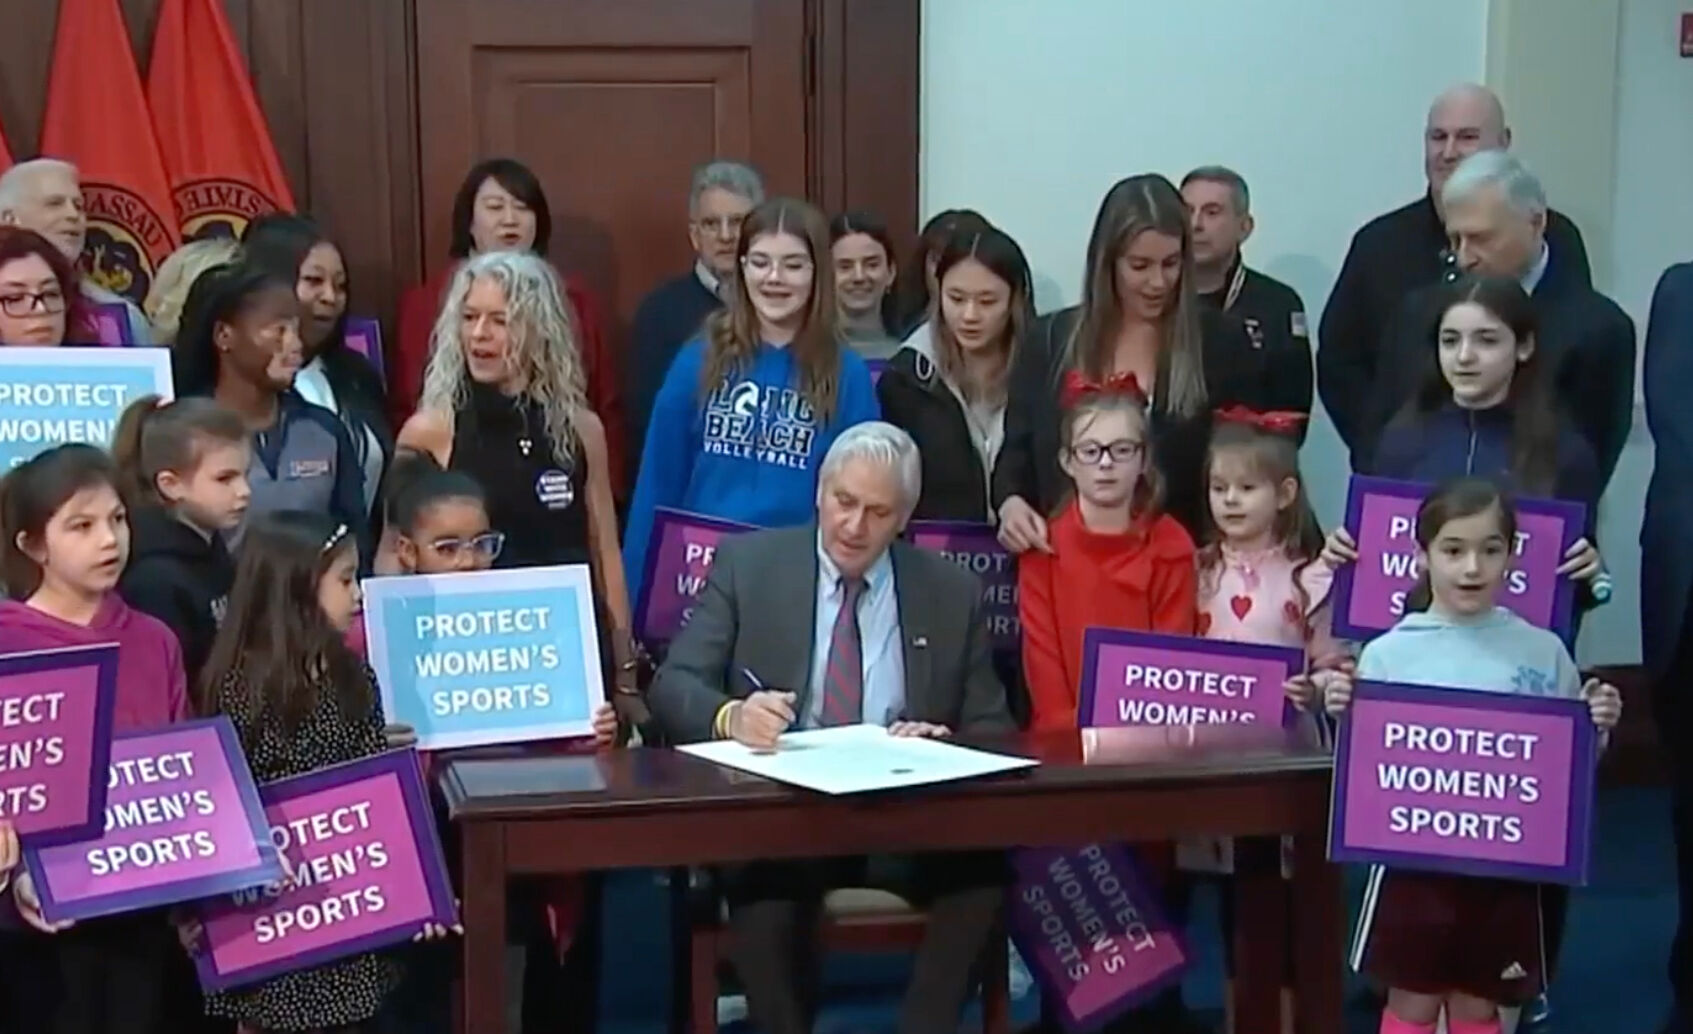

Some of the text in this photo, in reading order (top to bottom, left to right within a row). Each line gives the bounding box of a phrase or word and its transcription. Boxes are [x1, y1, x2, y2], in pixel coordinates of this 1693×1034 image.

[0, 383, 128, 407] PROTECT
[704, 410, 814, 456] BEACH
[703, 441, 808, 470] VOLLEYBALL
[415, 607, 550, 640] PROTECT
[415, 644, 560, 678] WOMEN'S
[433, 682, 551, 716] SPORTS
[1125, 664, 1257, 699] PROTECT
[0, 692, 65, 726] ECT
[1384, 722, 1539, 761] PROTECT
[1377, 763, 1540, 803] WOMEN'S
[1389, 806, 1523, 843] SPORTS
[87, 831, 216, 875] SPORTS
[254, 885, 385, 943] SPORTS
[1049, 856, 1126, 974] WOMEN'S
[1080, 845, 1156, 952] PROTECT
[1023, 885, 1090, 981] SPORTS
